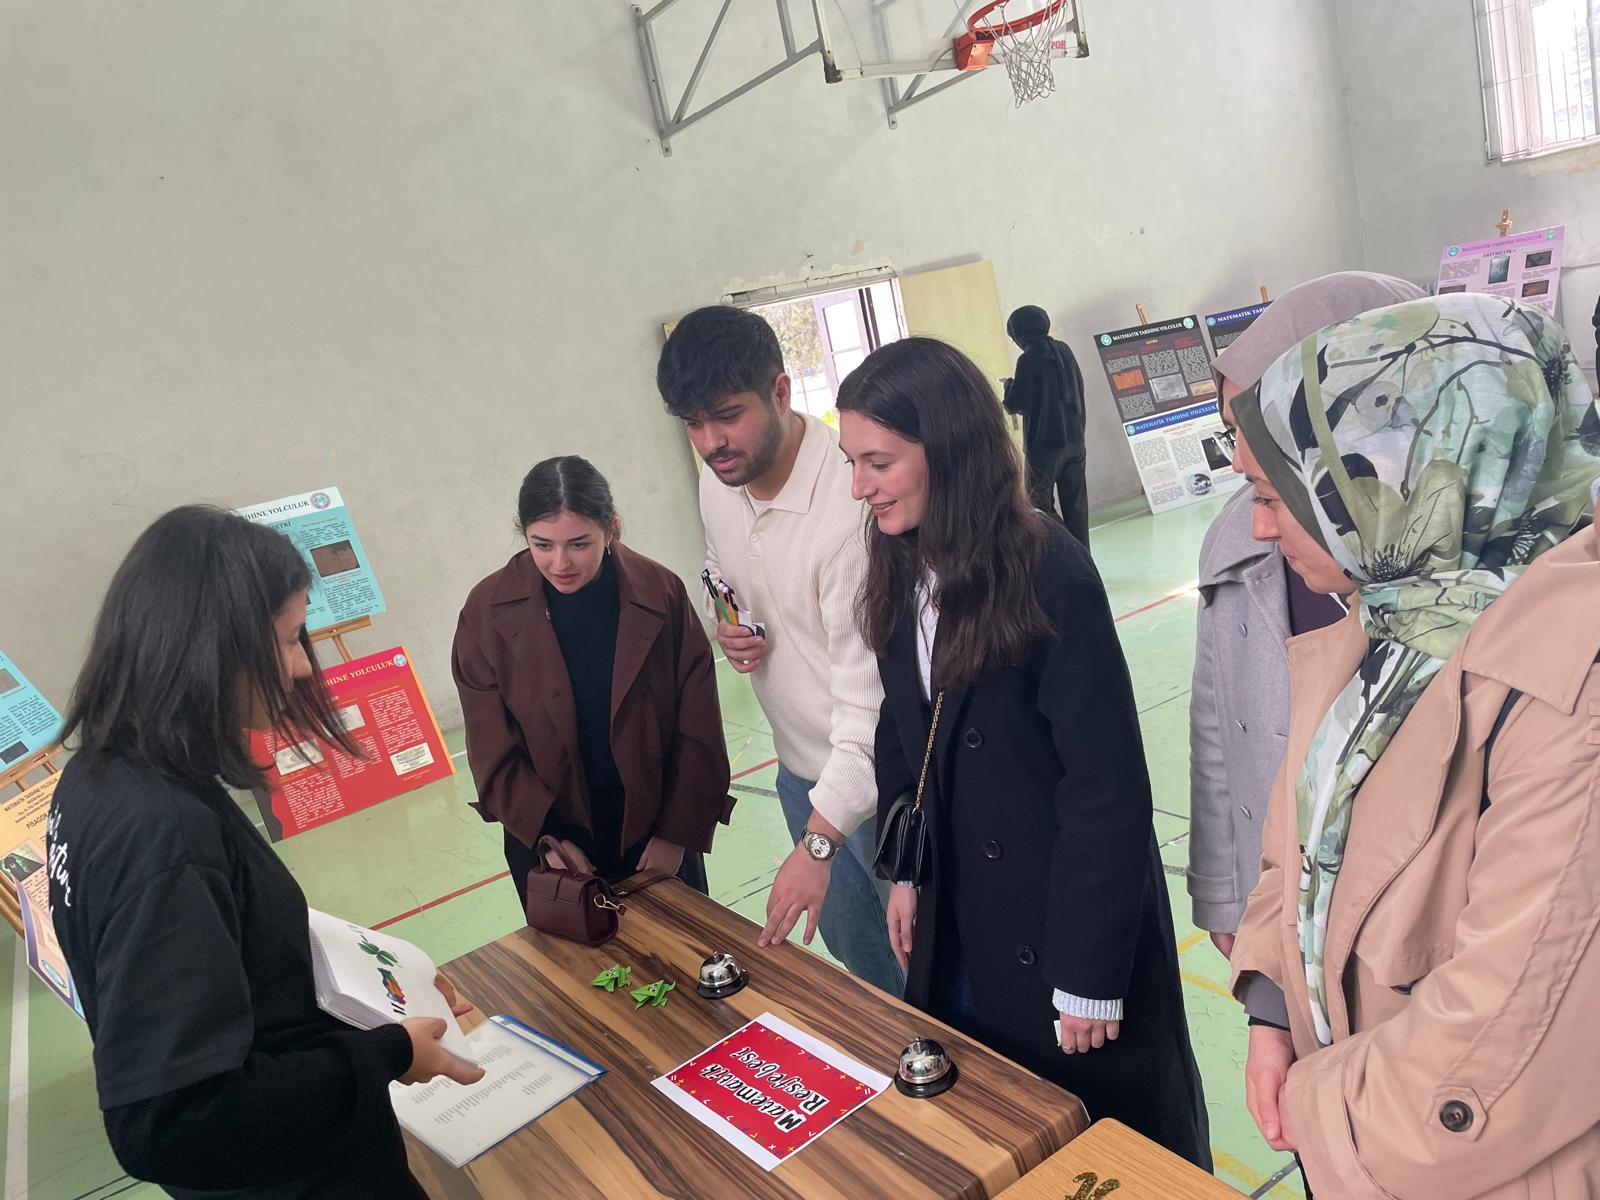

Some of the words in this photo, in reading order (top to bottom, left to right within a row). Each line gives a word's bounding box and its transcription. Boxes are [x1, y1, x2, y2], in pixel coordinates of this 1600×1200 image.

[268, 500, 310, 515] YOLCULUK
[349, 660, 394, 678] YOLCULUK
[701, 1064, 804, 1131] Matematik
[729, 1047, 829, 1115] Resfebesi
